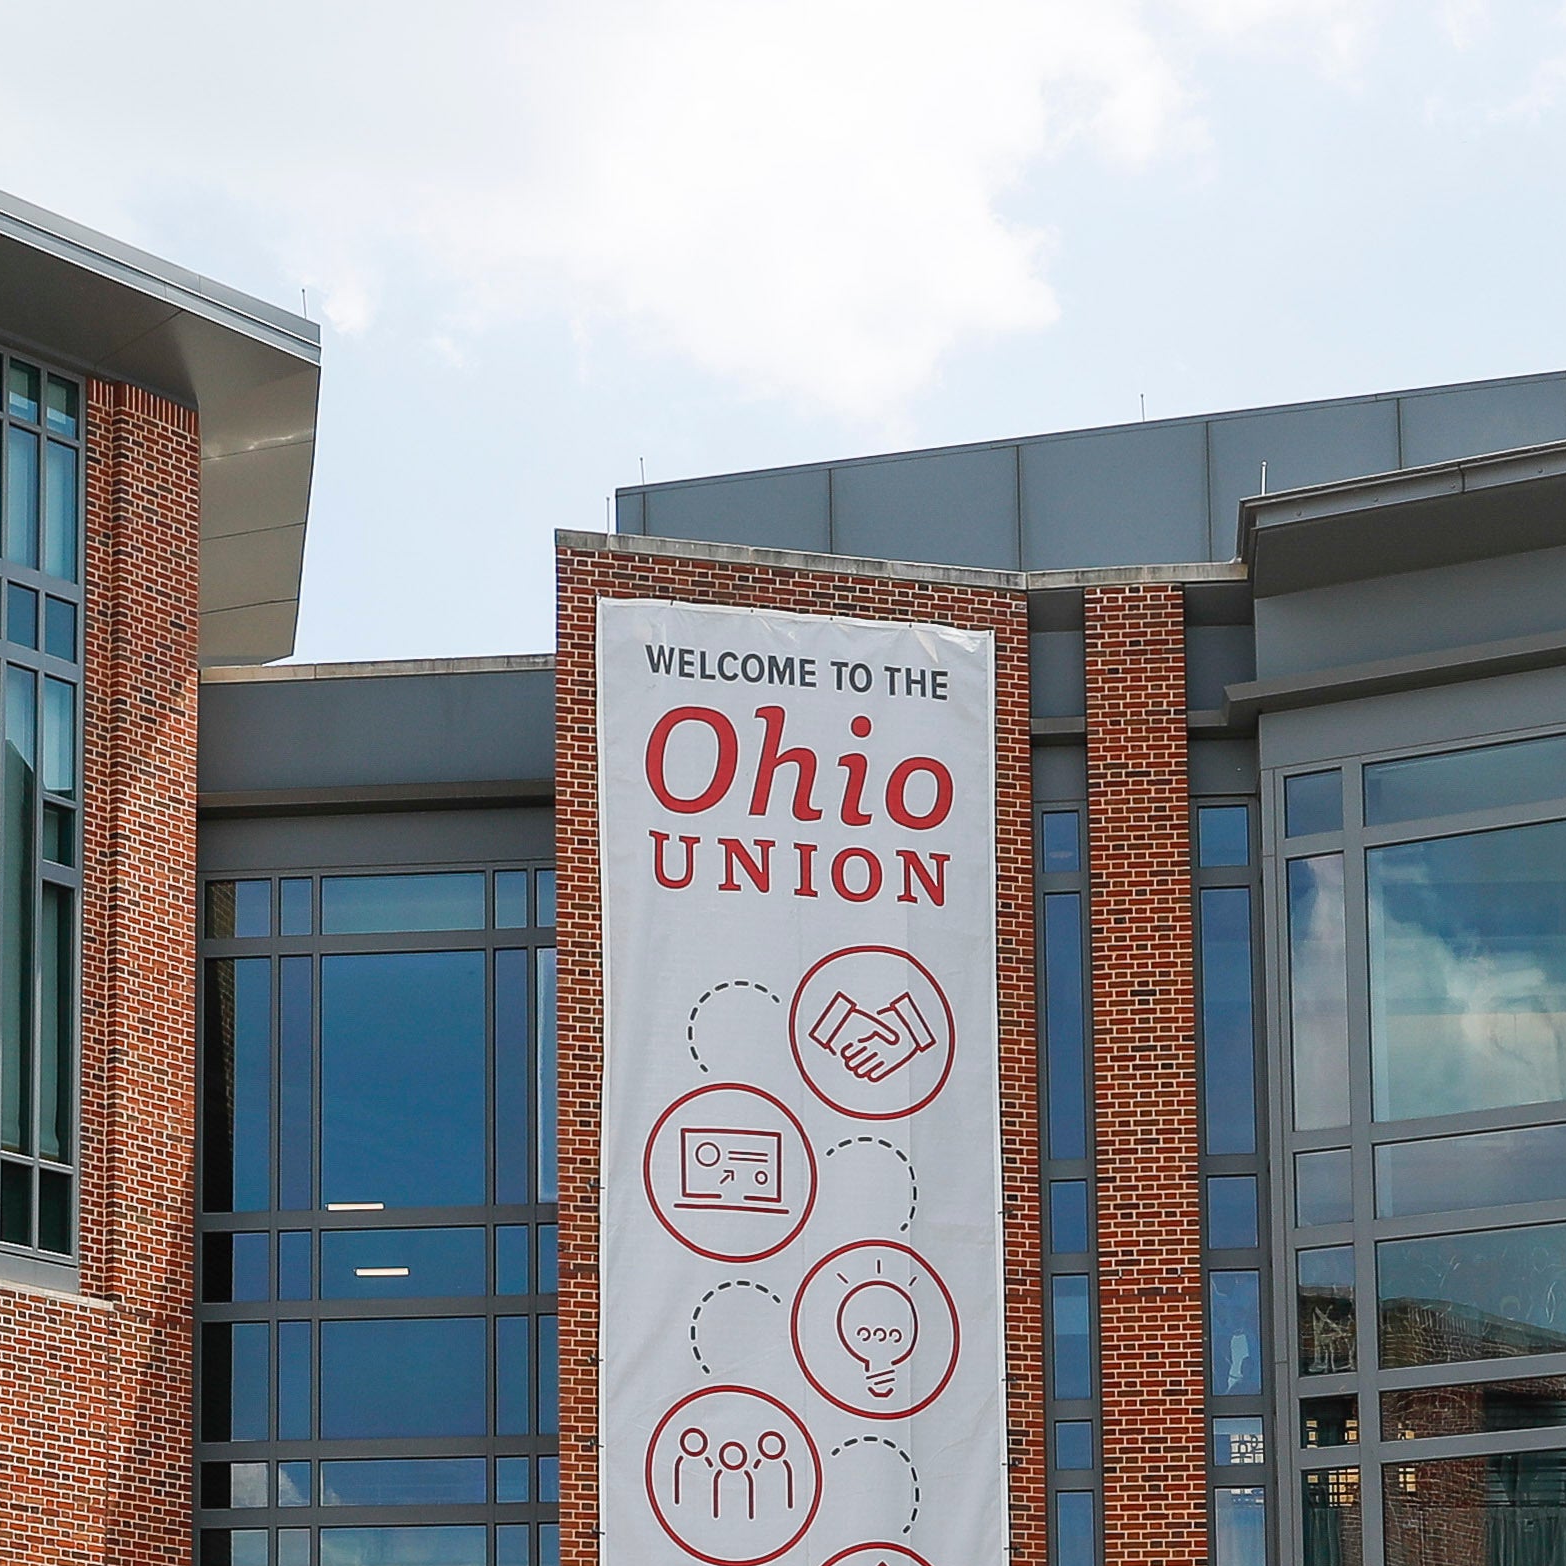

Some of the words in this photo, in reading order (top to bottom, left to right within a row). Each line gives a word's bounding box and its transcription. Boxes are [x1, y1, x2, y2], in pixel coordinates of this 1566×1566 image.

[645, 645, 816, 687] WELCOME
[830, 660, 873, 692] TO
[884, 666, 949, 700] THE
[645, 705, 954, 830] Ohio
[649, 830, 951, 906] UNION
